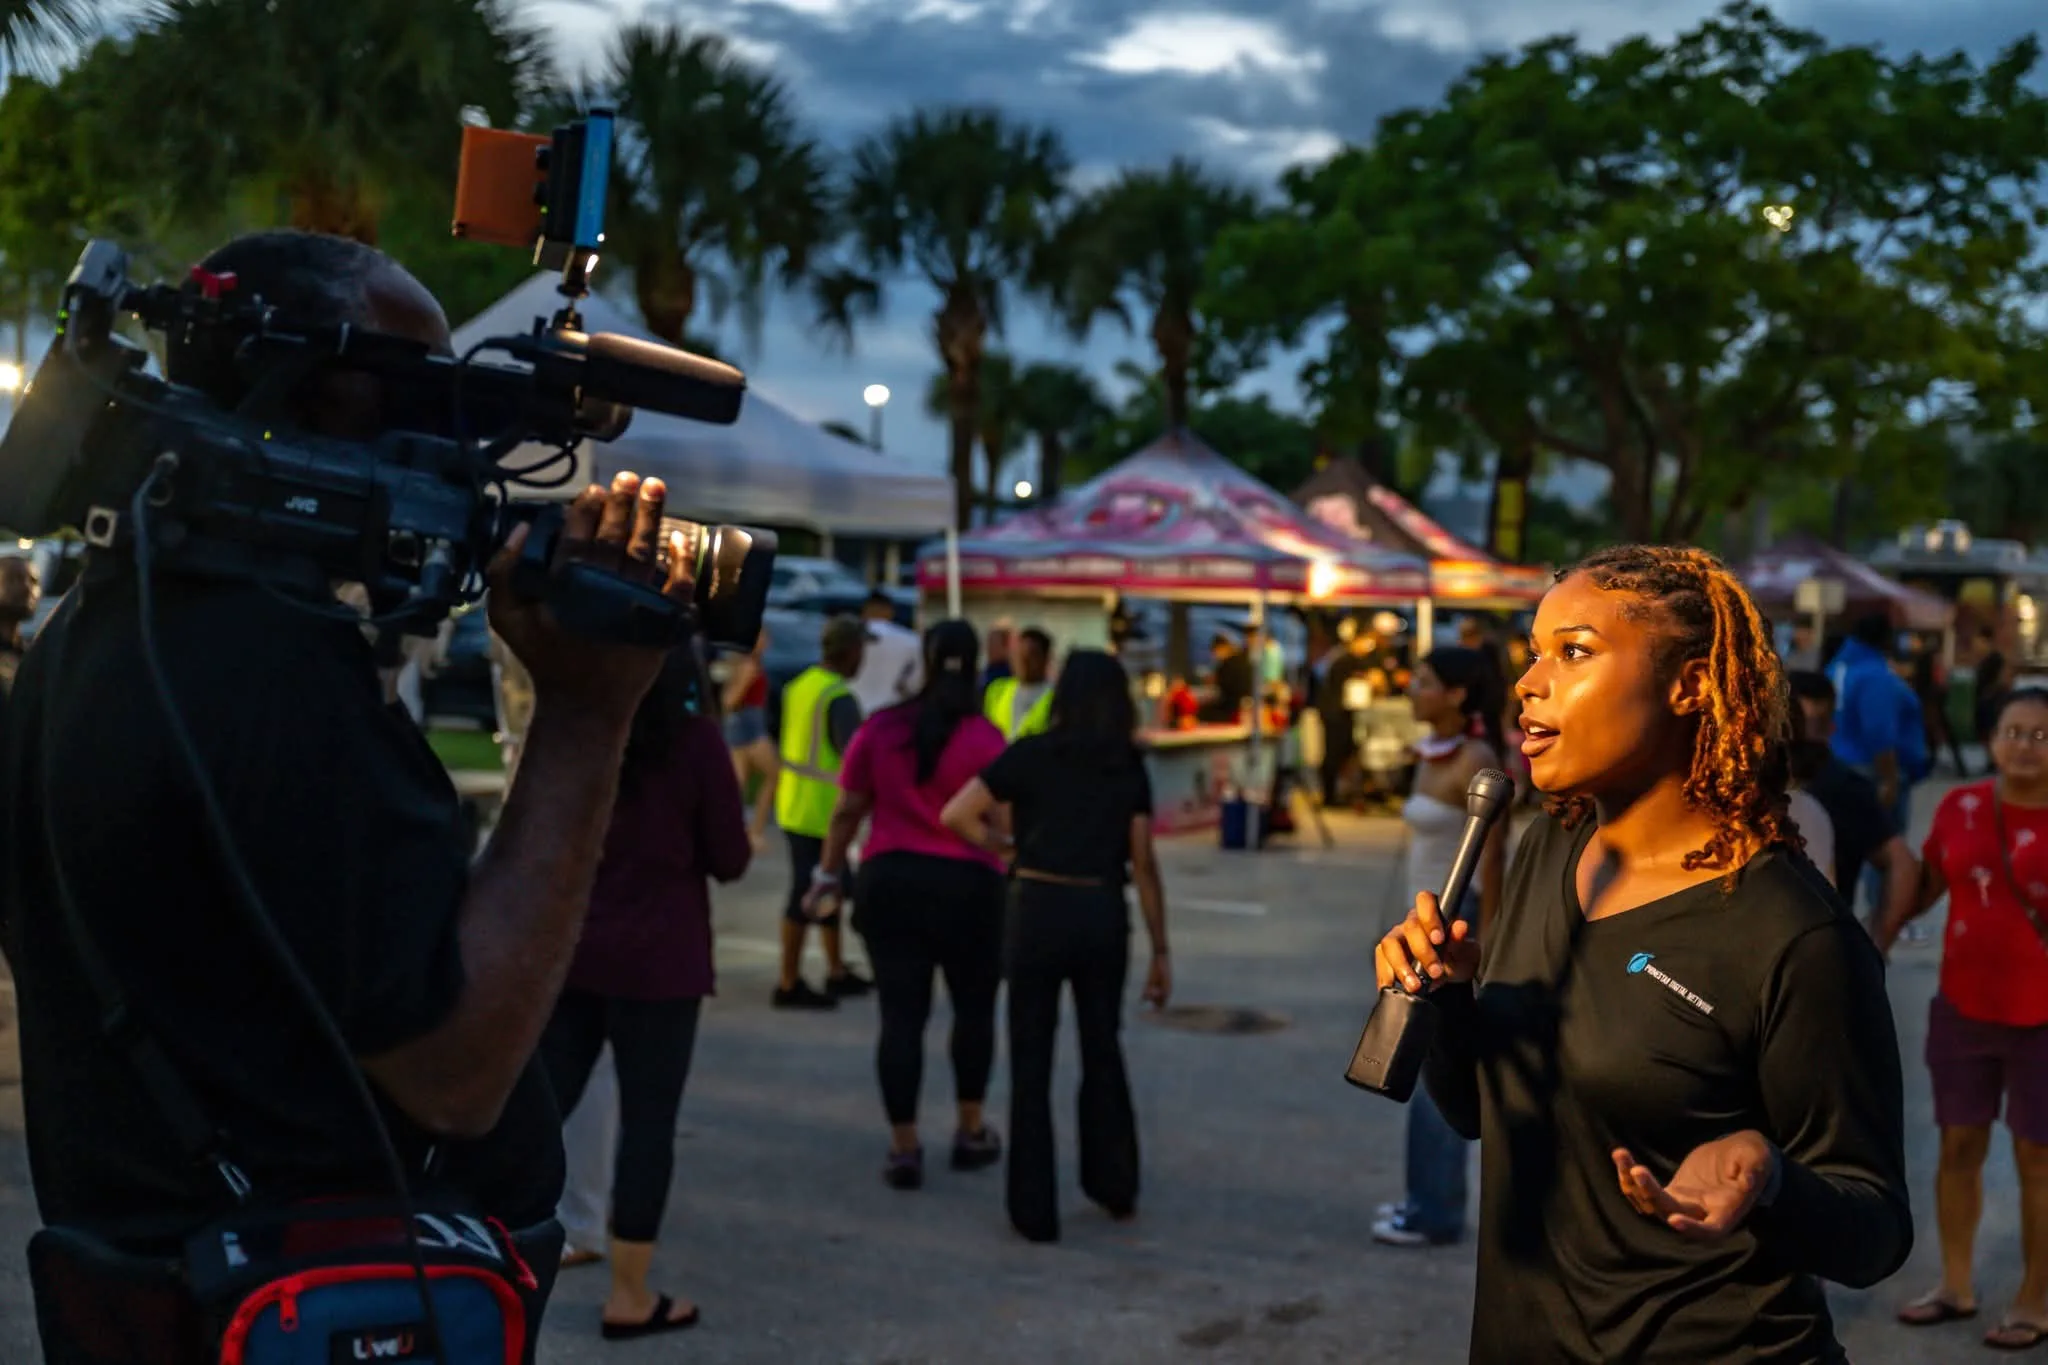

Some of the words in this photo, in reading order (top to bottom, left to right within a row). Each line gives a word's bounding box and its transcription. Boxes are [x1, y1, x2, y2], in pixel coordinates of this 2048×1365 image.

[285, 496, 318, 513] JVC
[1686, 991, 1714, 1015] NETWORK
[353, 1333, 414, 1360] LiveU
